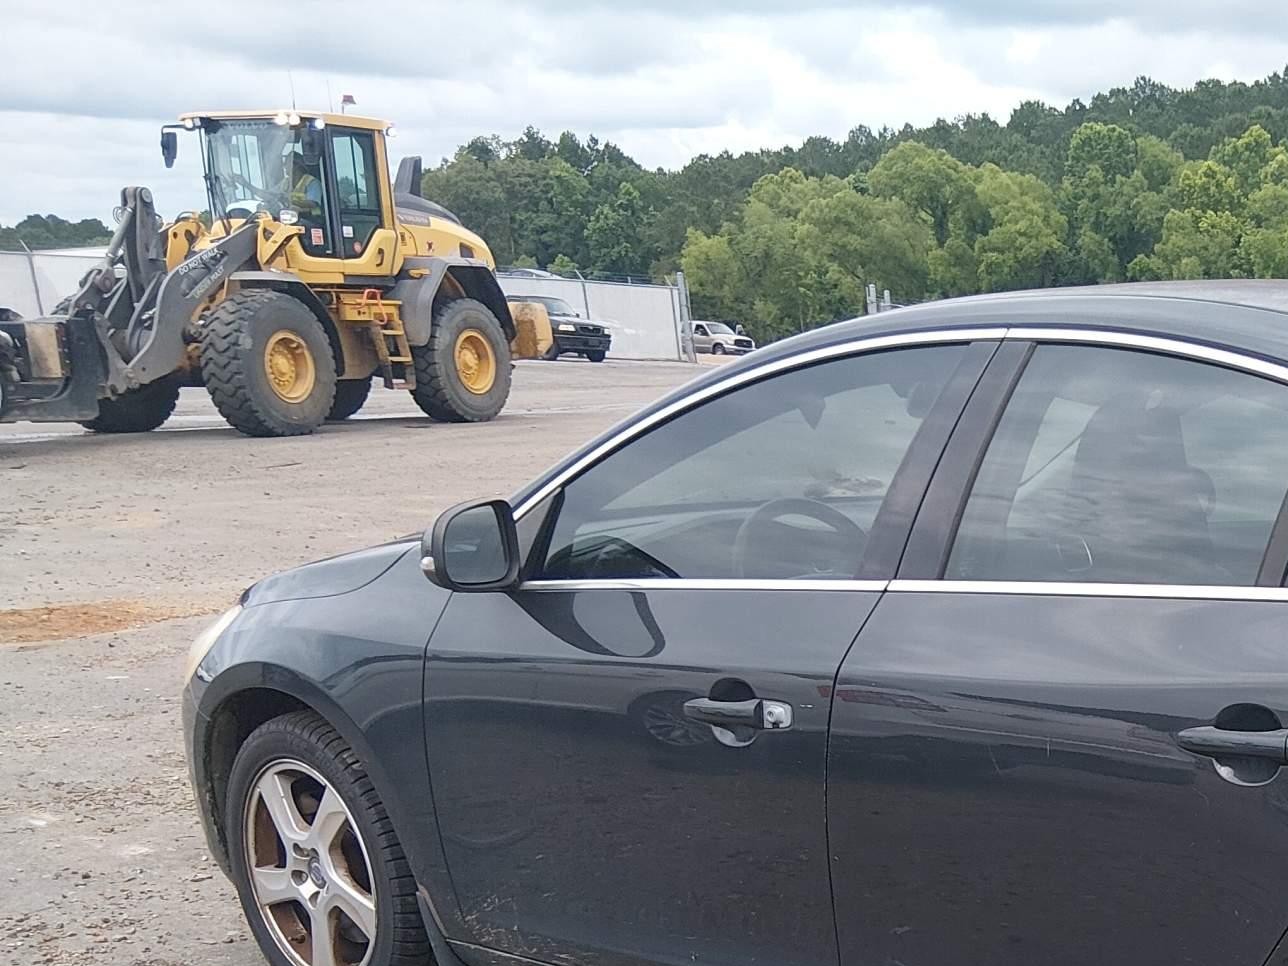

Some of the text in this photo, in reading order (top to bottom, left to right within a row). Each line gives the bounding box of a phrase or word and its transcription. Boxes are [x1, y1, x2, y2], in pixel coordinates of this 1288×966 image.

[179, 247, 219, 275] DO NOT WALK
